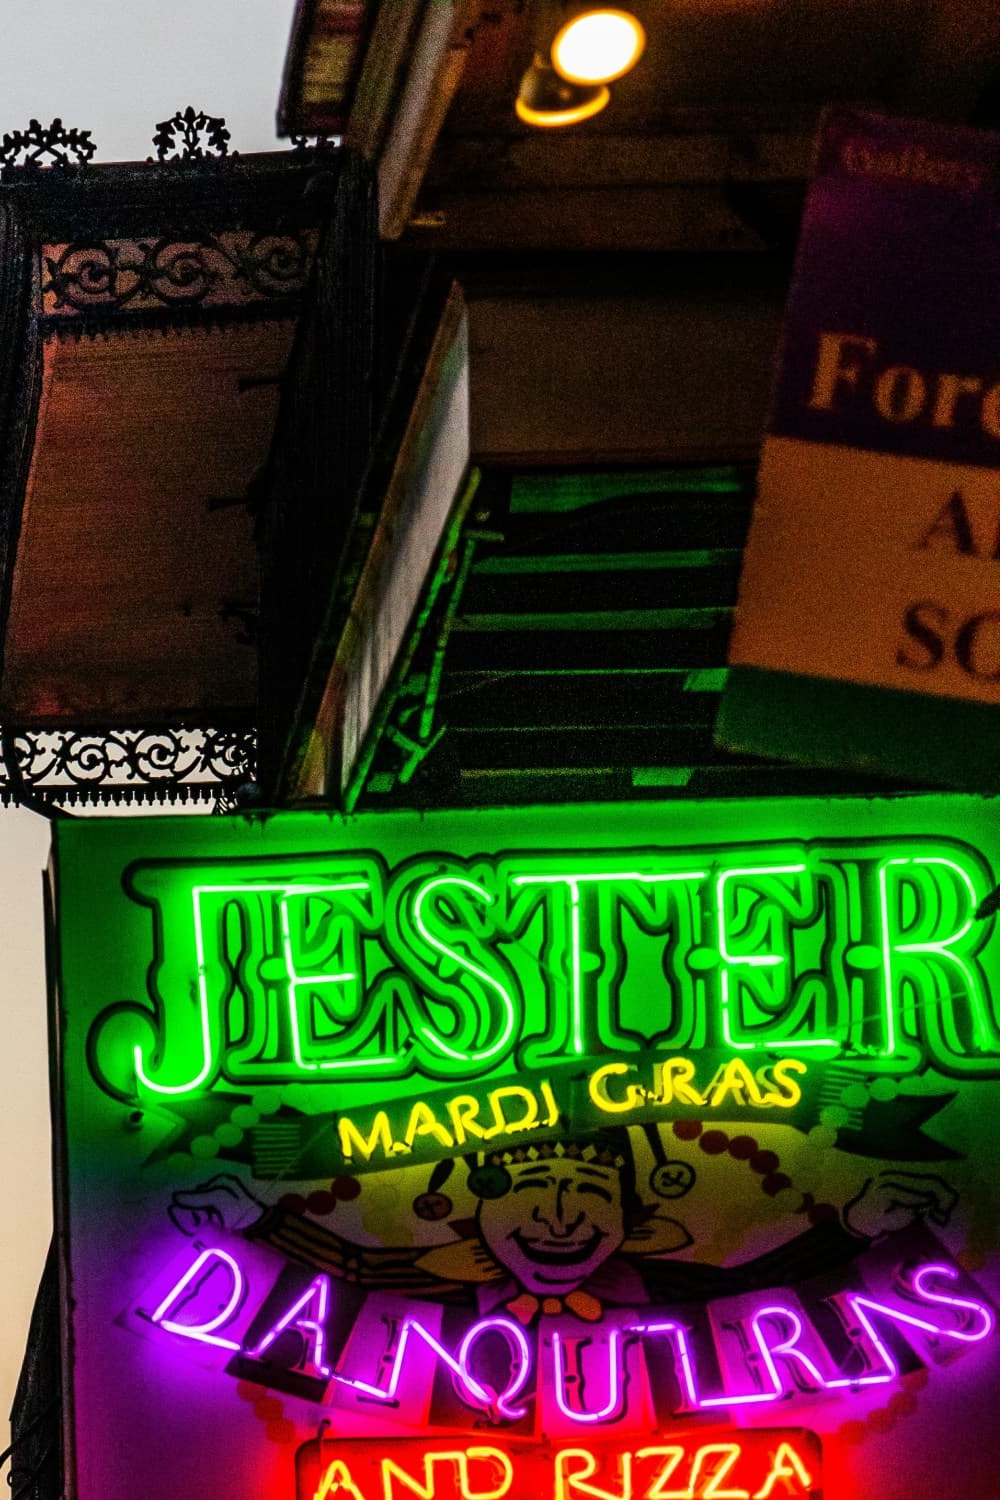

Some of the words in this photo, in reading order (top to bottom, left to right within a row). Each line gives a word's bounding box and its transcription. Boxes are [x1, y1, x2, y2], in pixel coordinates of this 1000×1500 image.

[914, 490, 1000, 562] A
[337, 1079, 560, 1164] MARDI
[588, 1056, 810, 1113] GRAS
